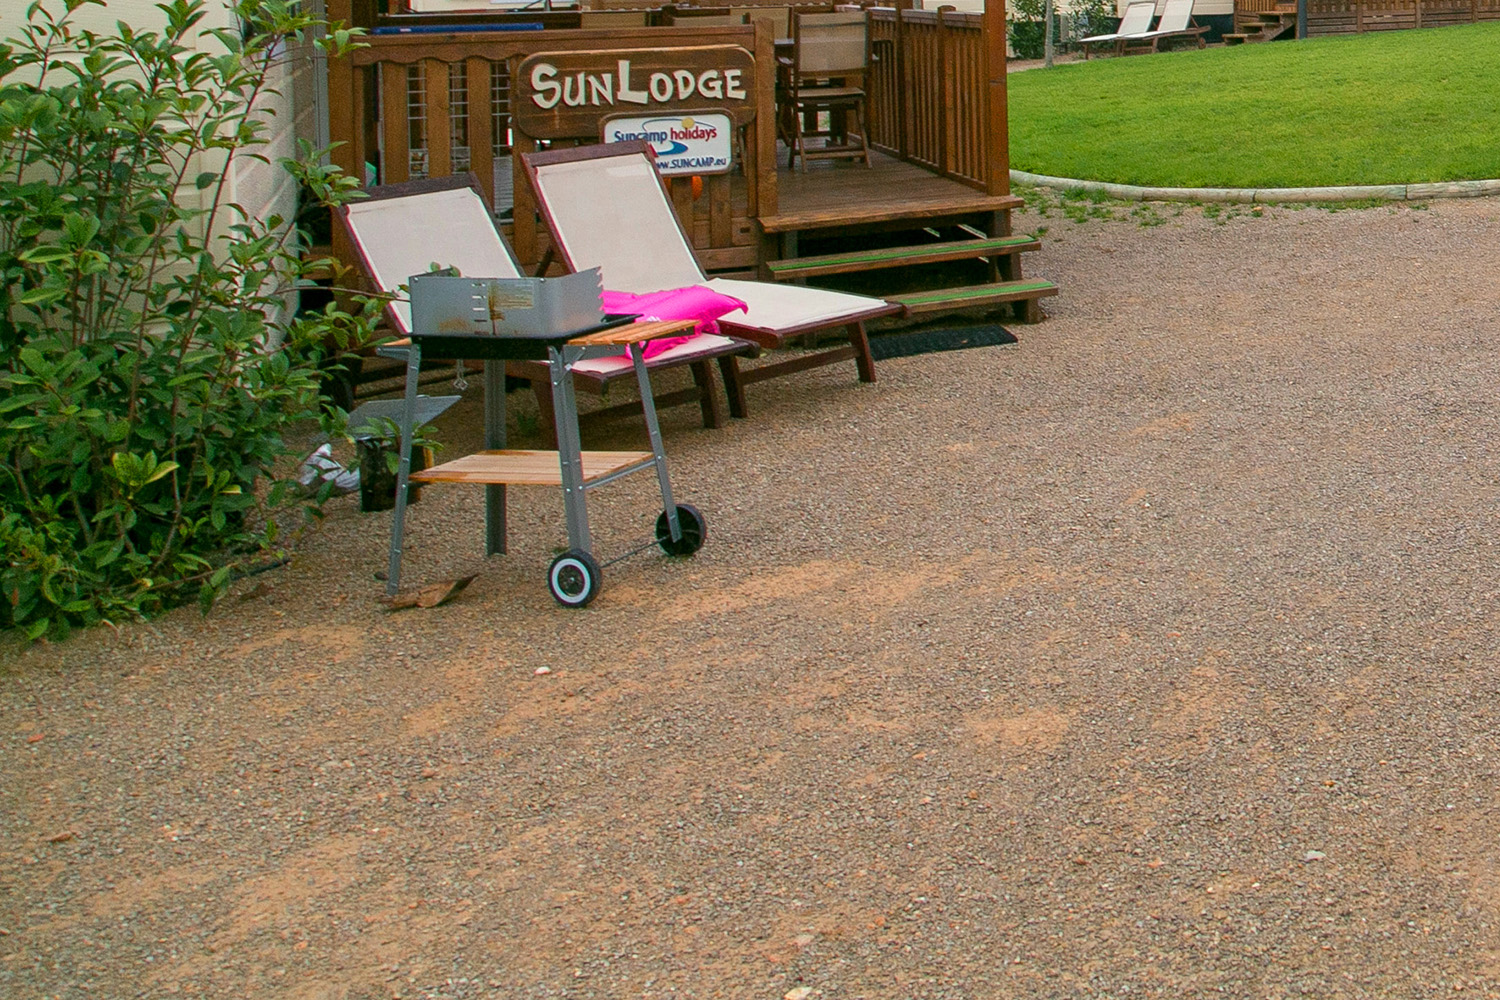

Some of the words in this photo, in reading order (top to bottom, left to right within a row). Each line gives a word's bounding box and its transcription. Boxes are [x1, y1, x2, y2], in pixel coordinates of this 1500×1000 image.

[531, 60, 747, 109] SUNLODGE
[614, 130, 668, 144] Suncamp
[670, 126, 717, 142] holidays
[656, 157, 726, 169] ww.SUNCAMP.eu
